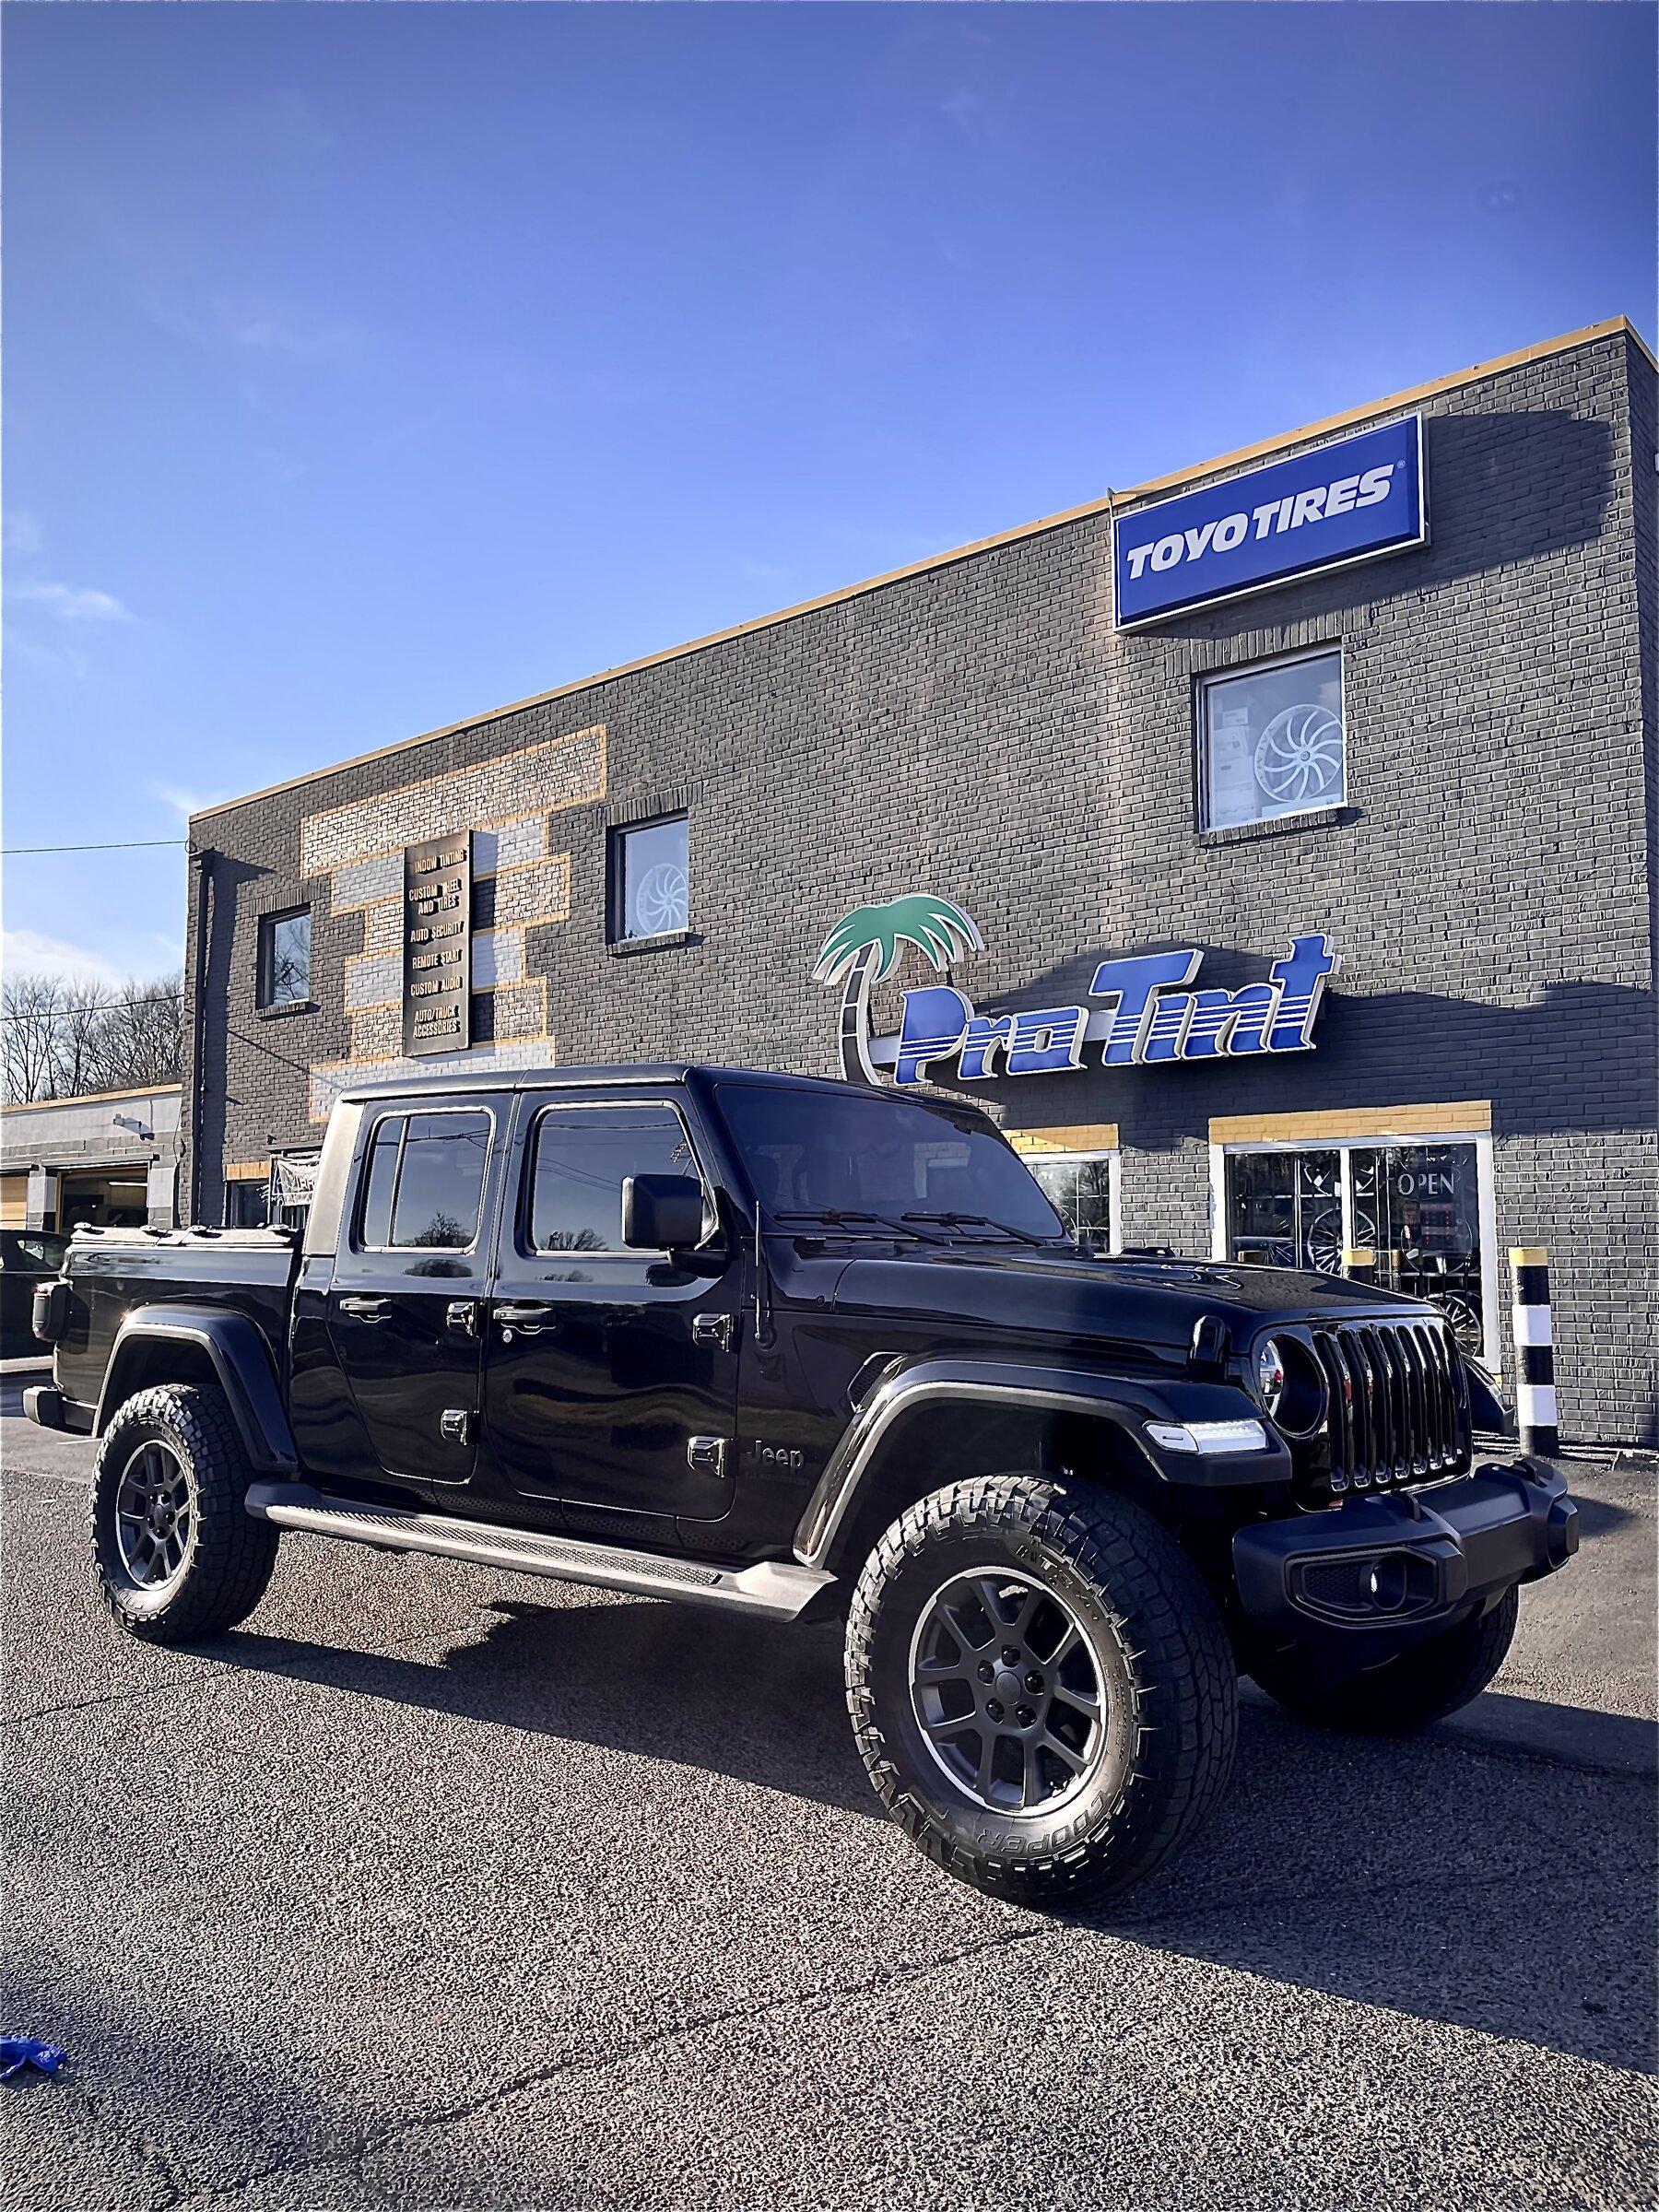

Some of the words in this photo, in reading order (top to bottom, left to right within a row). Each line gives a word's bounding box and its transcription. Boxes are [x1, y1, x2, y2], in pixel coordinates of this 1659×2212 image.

[1126, 512, 1248, 580] TOYO
[1252, 464, 1394, 540] TIRES
[439, 849, 464, 867] TINTING
[408, 885, 438, 901] CUSTOM
[418, 900, 434, 914] AND
[438, 895, 456, 910] TIRES
[410, 927, 429, 942] AUTO
[431, 922, 462, 938] SECURITY
[412, 954, 439, 969] REMOTE
[441, 949, 459, 964] START
[410, 980, 439, 995] CUSTOM
[441, 976, 461, 992] AUDIO
[414, 1005, 456, 1023] AUTO/TRUCK
[893, 984, 1088, 1087] Pro
[1088, 933, 1341, 1067] Tint
[413, 1019, 457, 1038] ACCESSORIES
[1397, 1172, 1454, 1195] OPEN
[746, 1440, 805, 1475] Jeep
[977, 1789, 1107, 1854] COOPER
